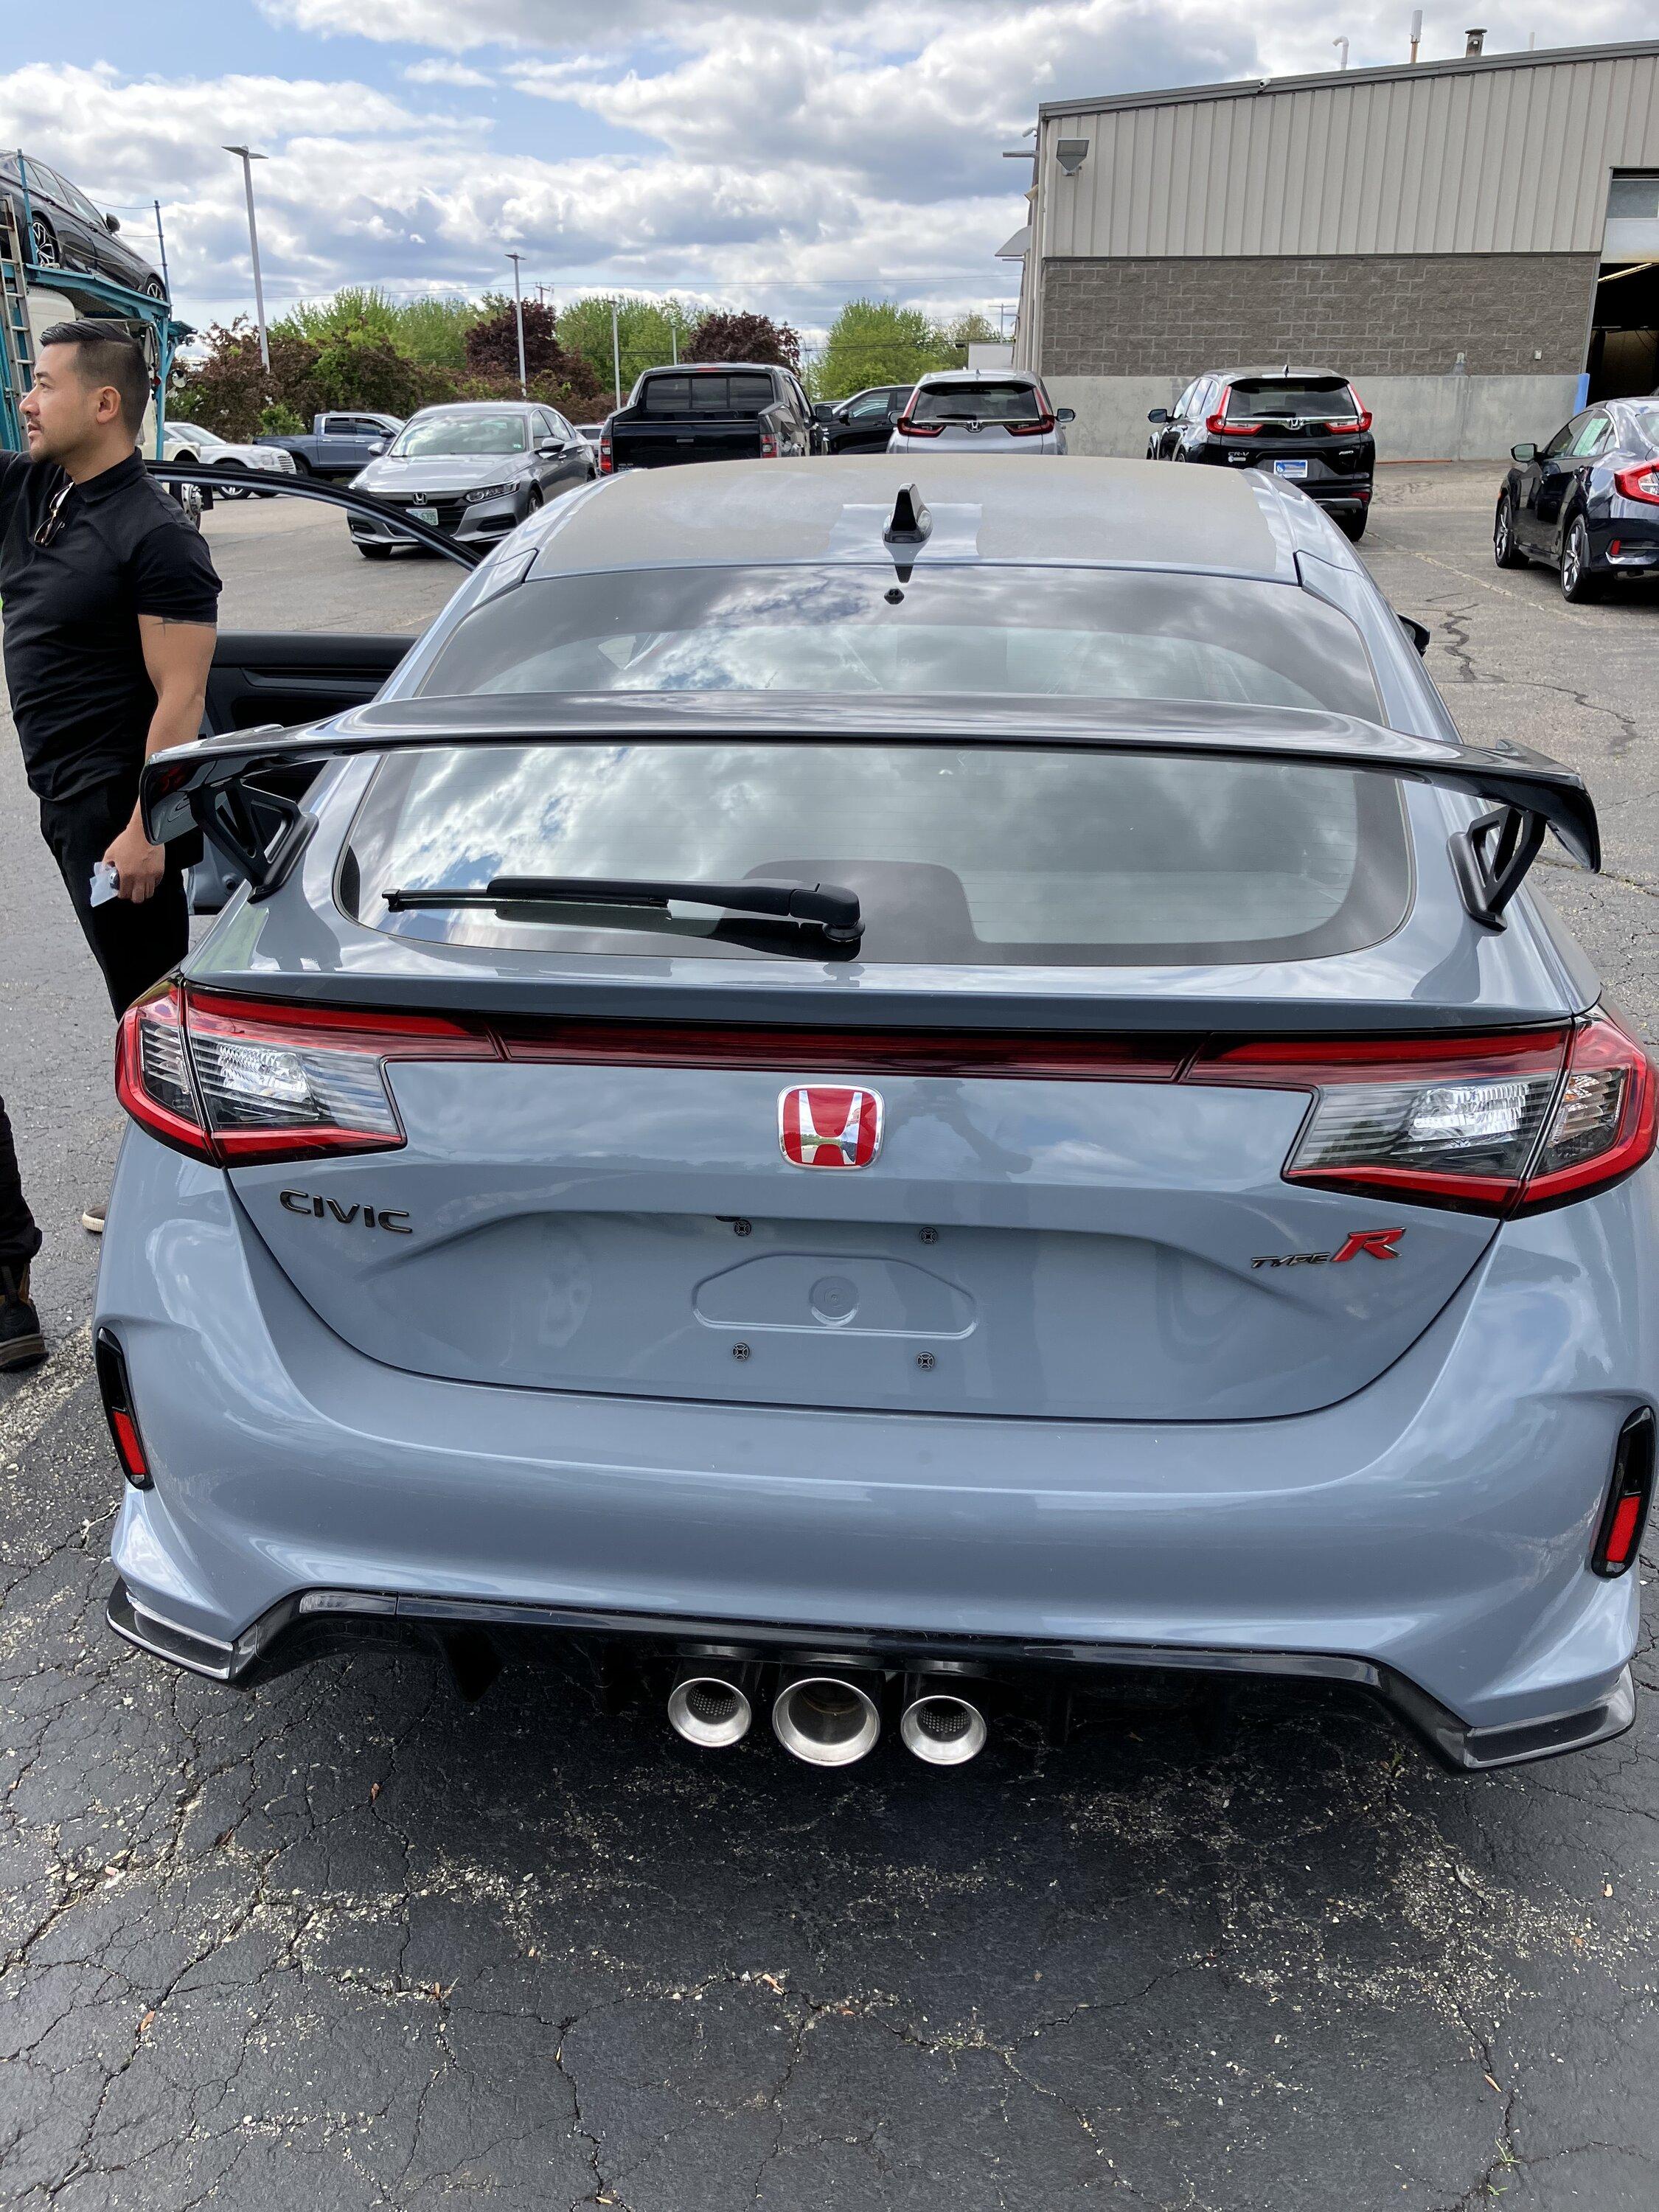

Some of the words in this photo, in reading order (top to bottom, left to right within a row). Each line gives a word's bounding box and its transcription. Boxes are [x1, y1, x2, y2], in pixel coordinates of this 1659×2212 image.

[279, 1188, 413, 1234] CIVIC
[1251, 1251, 1331, 1269] TYPE
[1329, 1226, 1406, 1263] R
